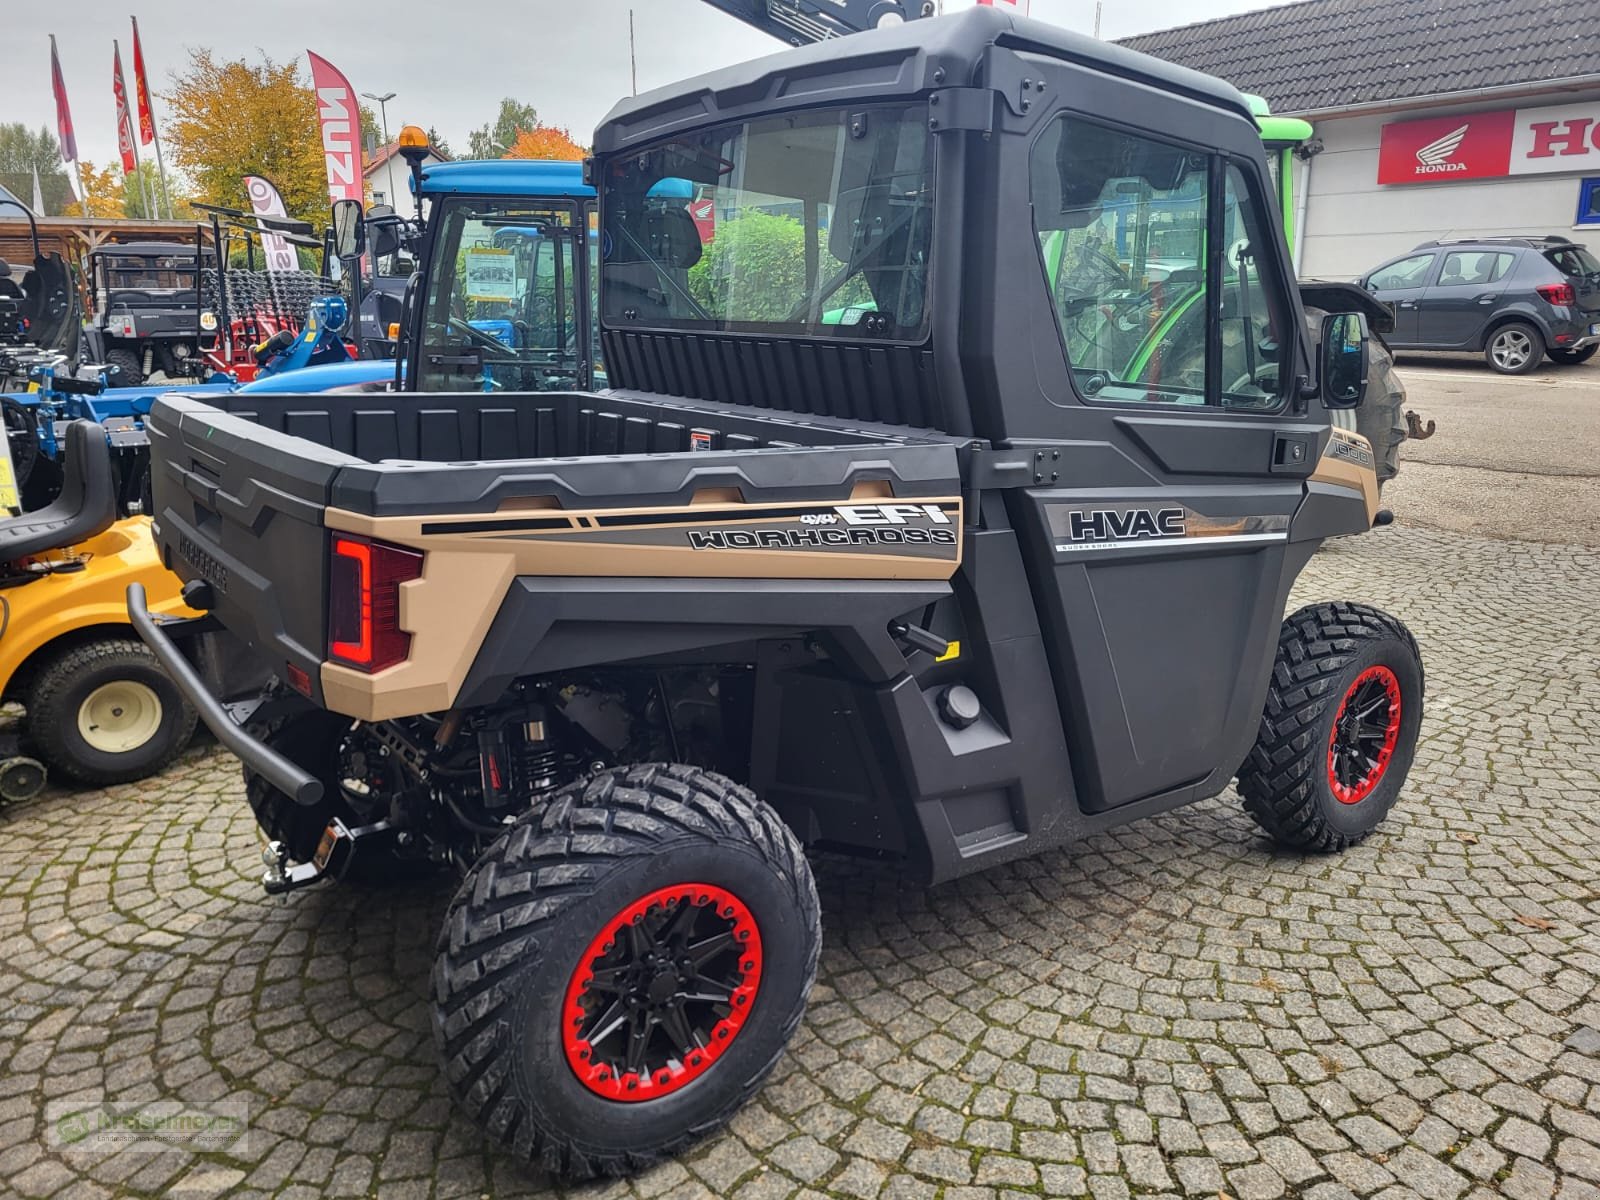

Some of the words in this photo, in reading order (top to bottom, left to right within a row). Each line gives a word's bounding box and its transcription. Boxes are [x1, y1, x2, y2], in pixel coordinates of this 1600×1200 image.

[1526, 117, 1600, 159] H
[1415, 162, 1468, 174] HONDA
[833, 504, 952, 525] EFI
[1068, 507, 1186, 541] HVAC
[687, 527, 957, 550] WORKCROSS
